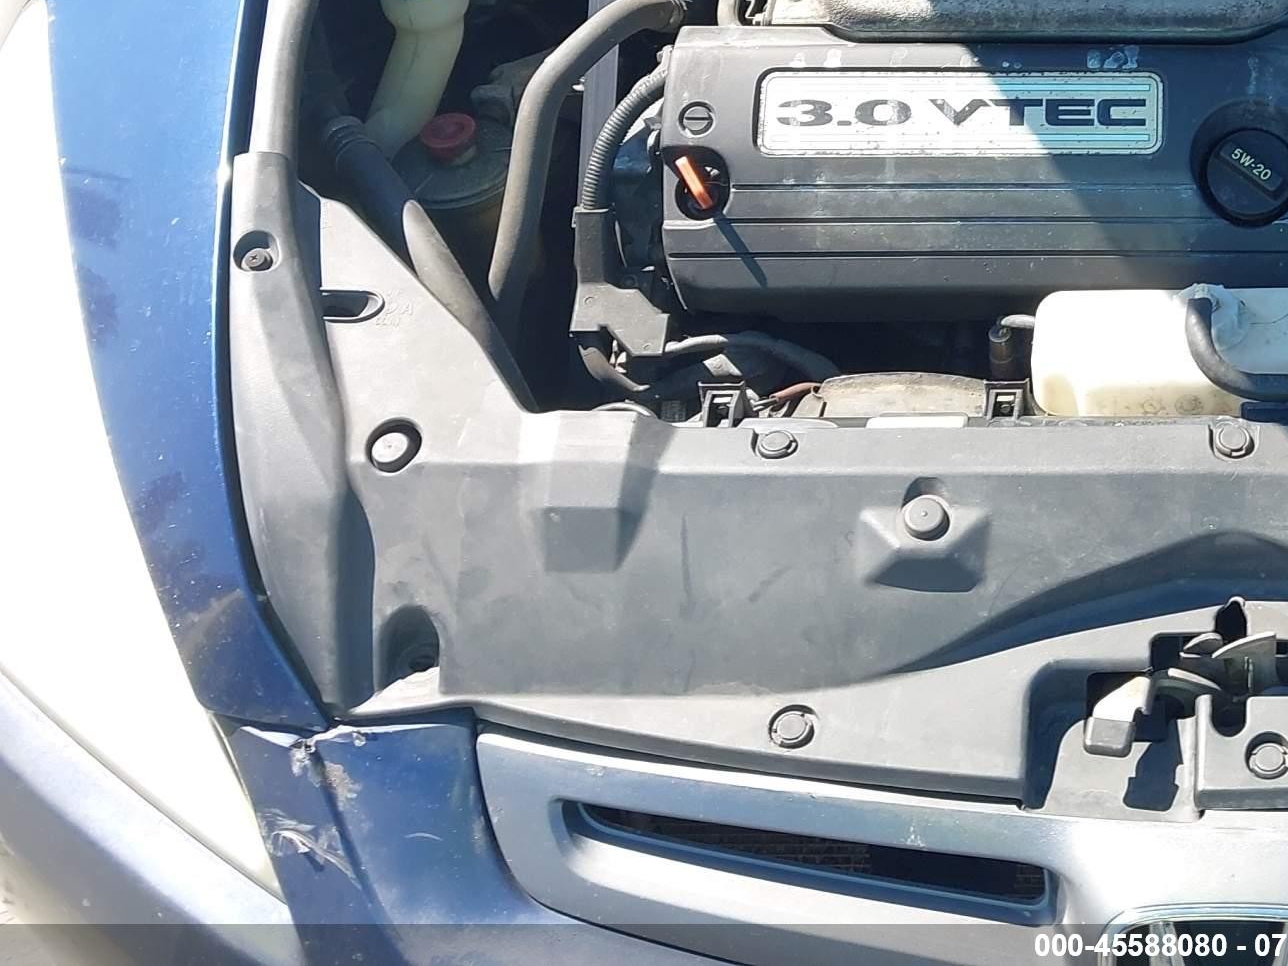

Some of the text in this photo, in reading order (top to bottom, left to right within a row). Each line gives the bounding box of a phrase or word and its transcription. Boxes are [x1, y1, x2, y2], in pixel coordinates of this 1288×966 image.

[776, 98, 1147, 127] 3.0 VTEC
[1231, 148, 1272, 180] 5W-20
